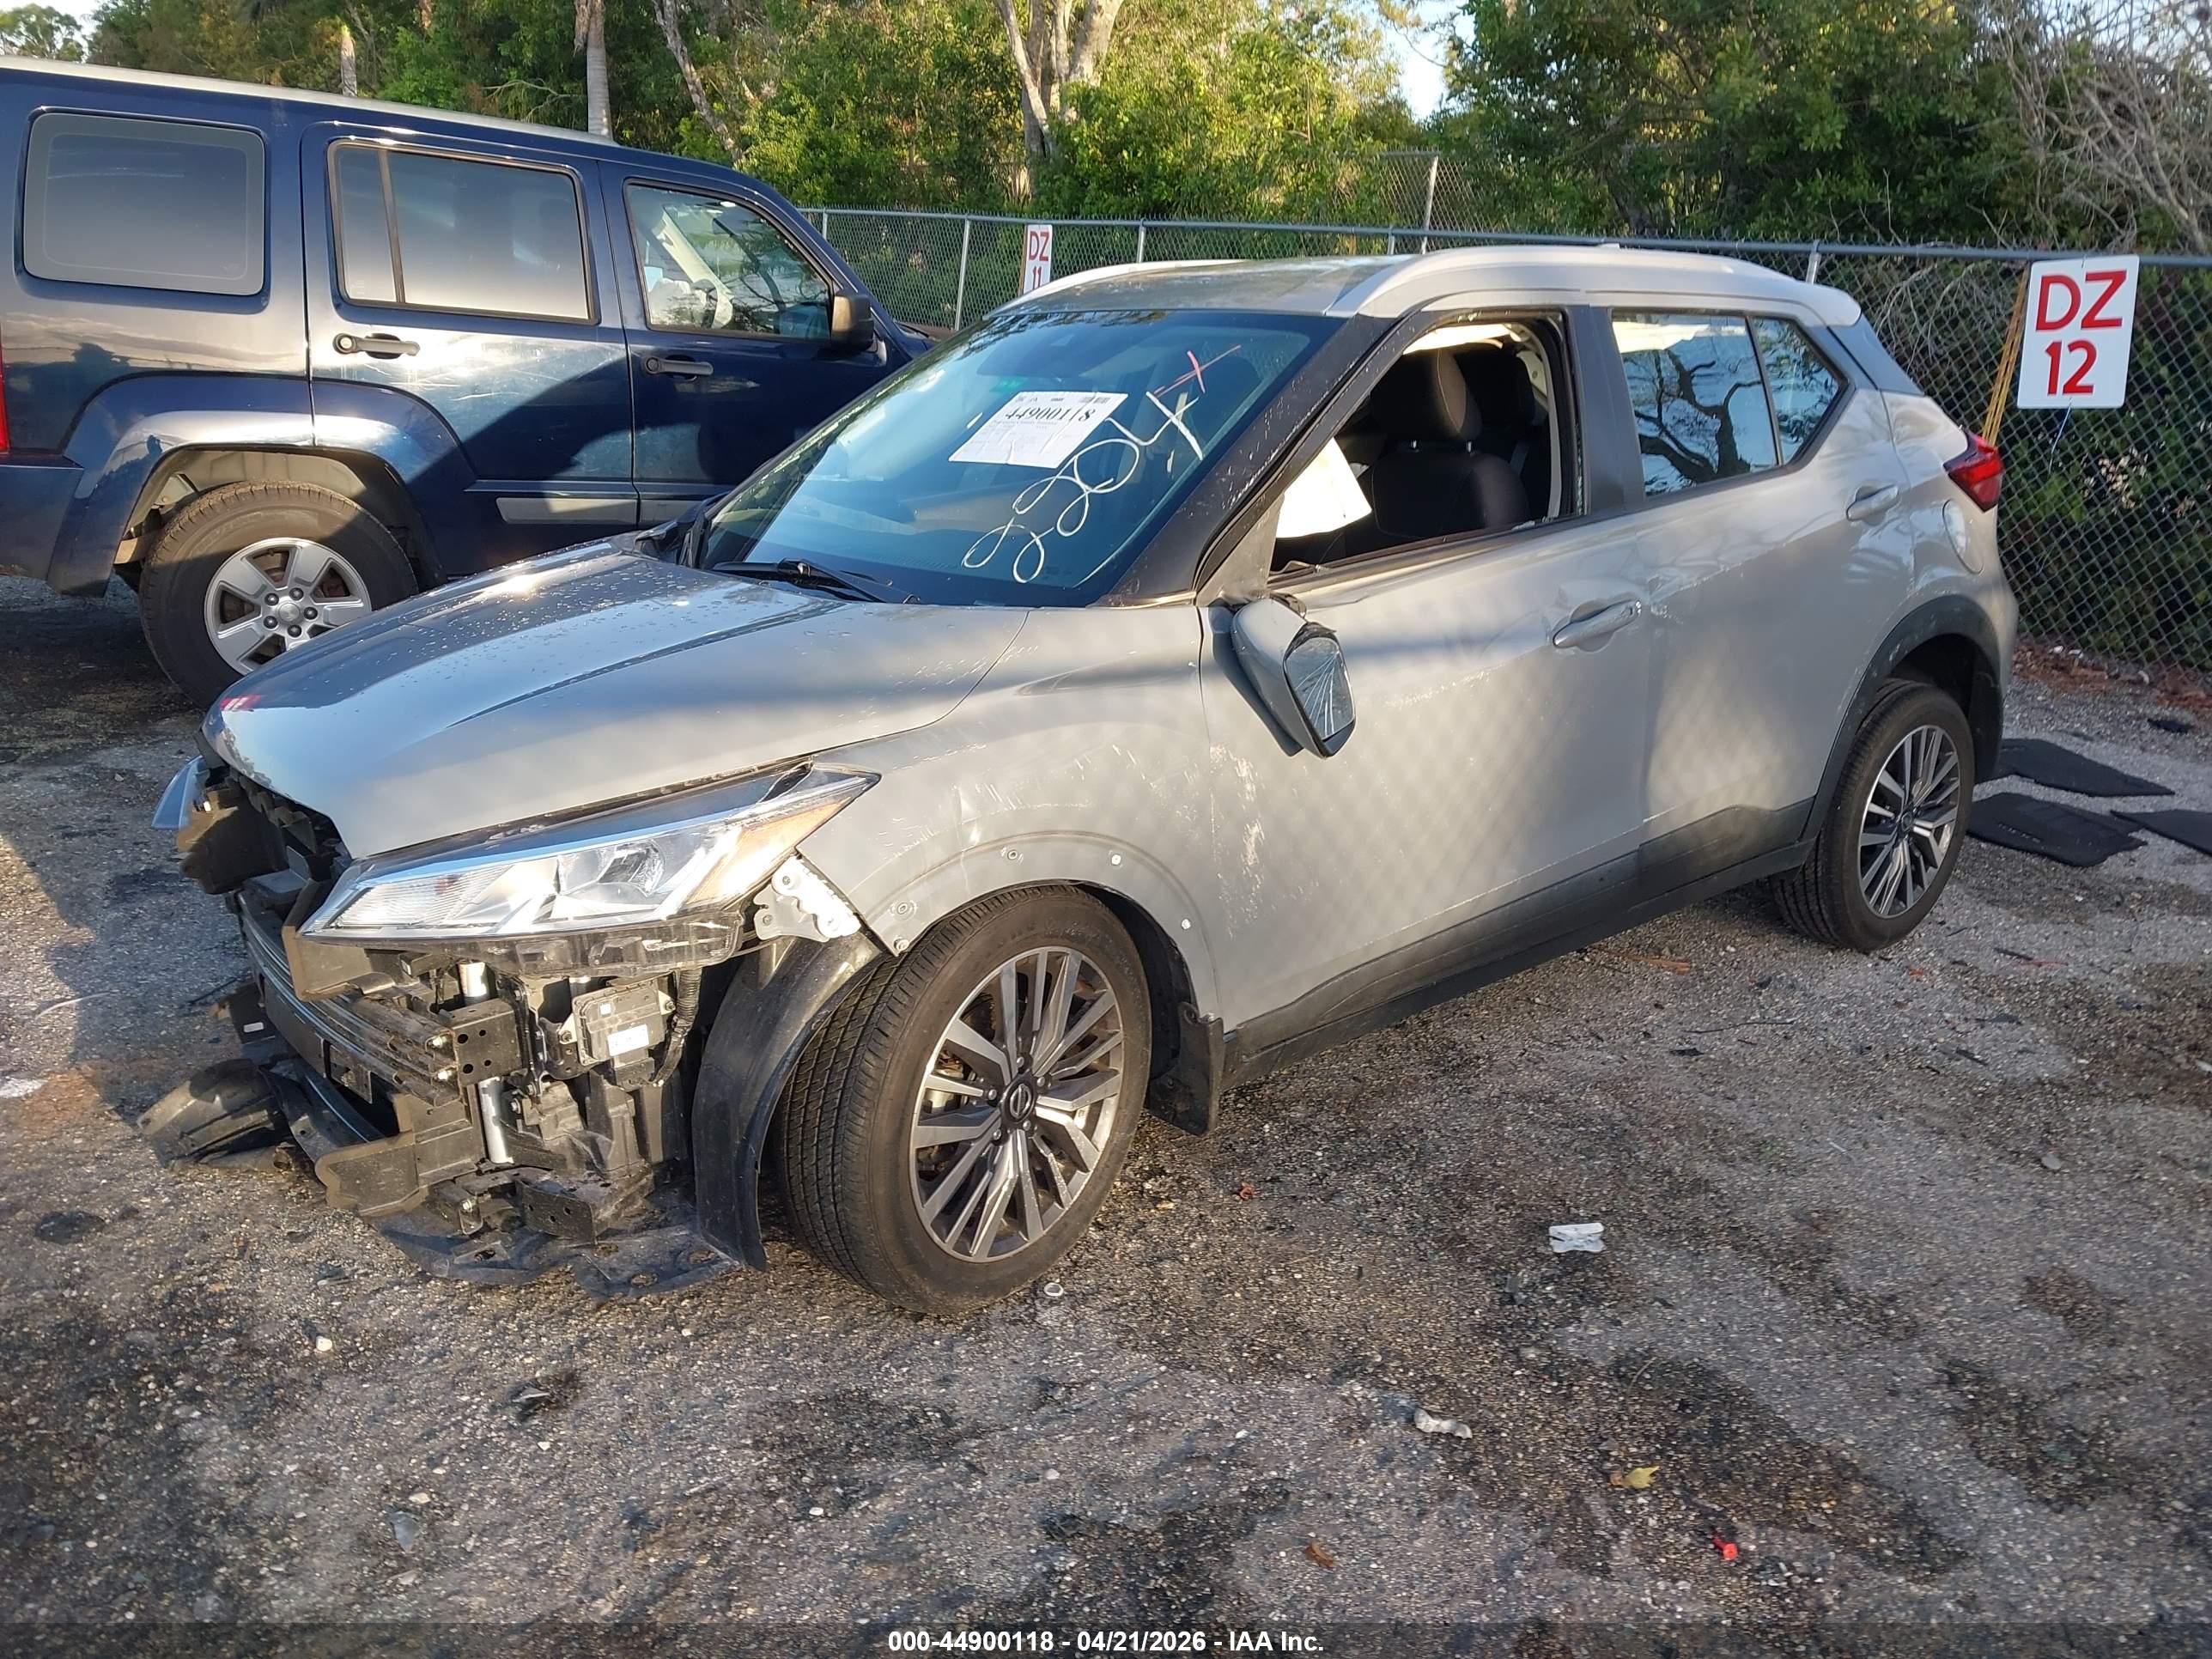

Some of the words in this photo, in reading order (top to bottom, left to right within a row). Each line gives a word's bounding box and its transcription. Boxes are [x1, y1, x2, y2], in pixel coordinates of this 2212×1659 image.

[1028, 231, 1050, 262] DZ
[2035, 270, 2128, 331] DZ
[2045, 339, 2097, 396] 12
